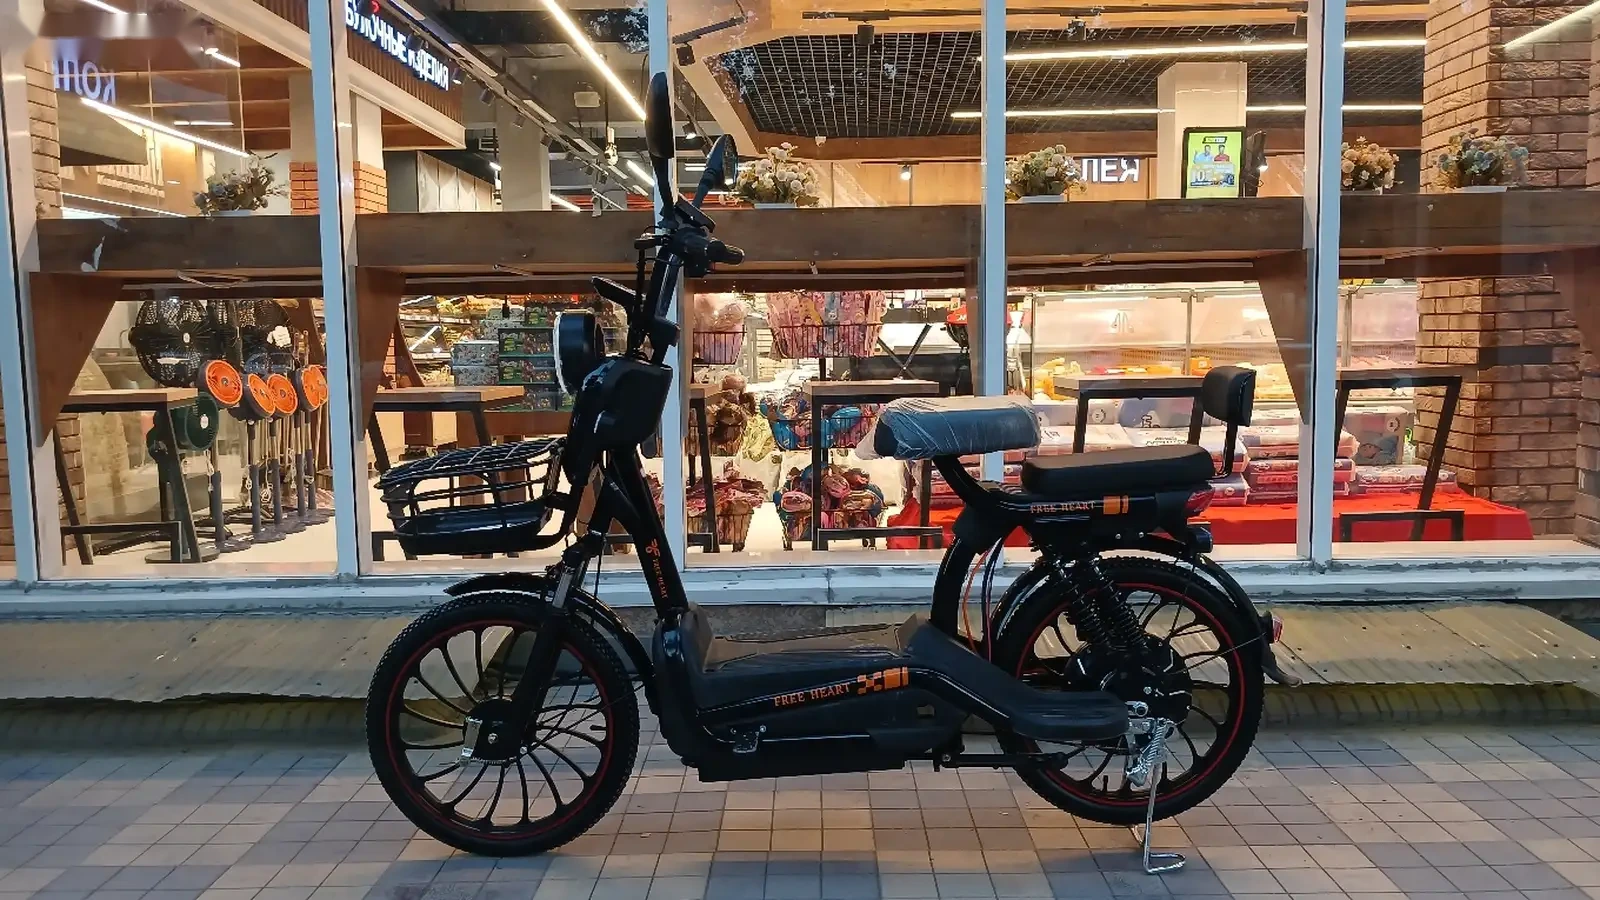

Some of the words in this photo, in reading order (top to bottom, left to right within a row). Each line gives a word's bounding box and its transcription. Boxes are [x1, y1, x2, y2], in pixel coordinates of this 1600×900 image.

[1064, 157, 1140, 182] ЛЕЯ
[1029, 503, 1058, 514] FREE
[1061, 501, 1097, 512] HEART
[774, 691, 806, 707] FREE
[810, 682, 851, 700] HEART
